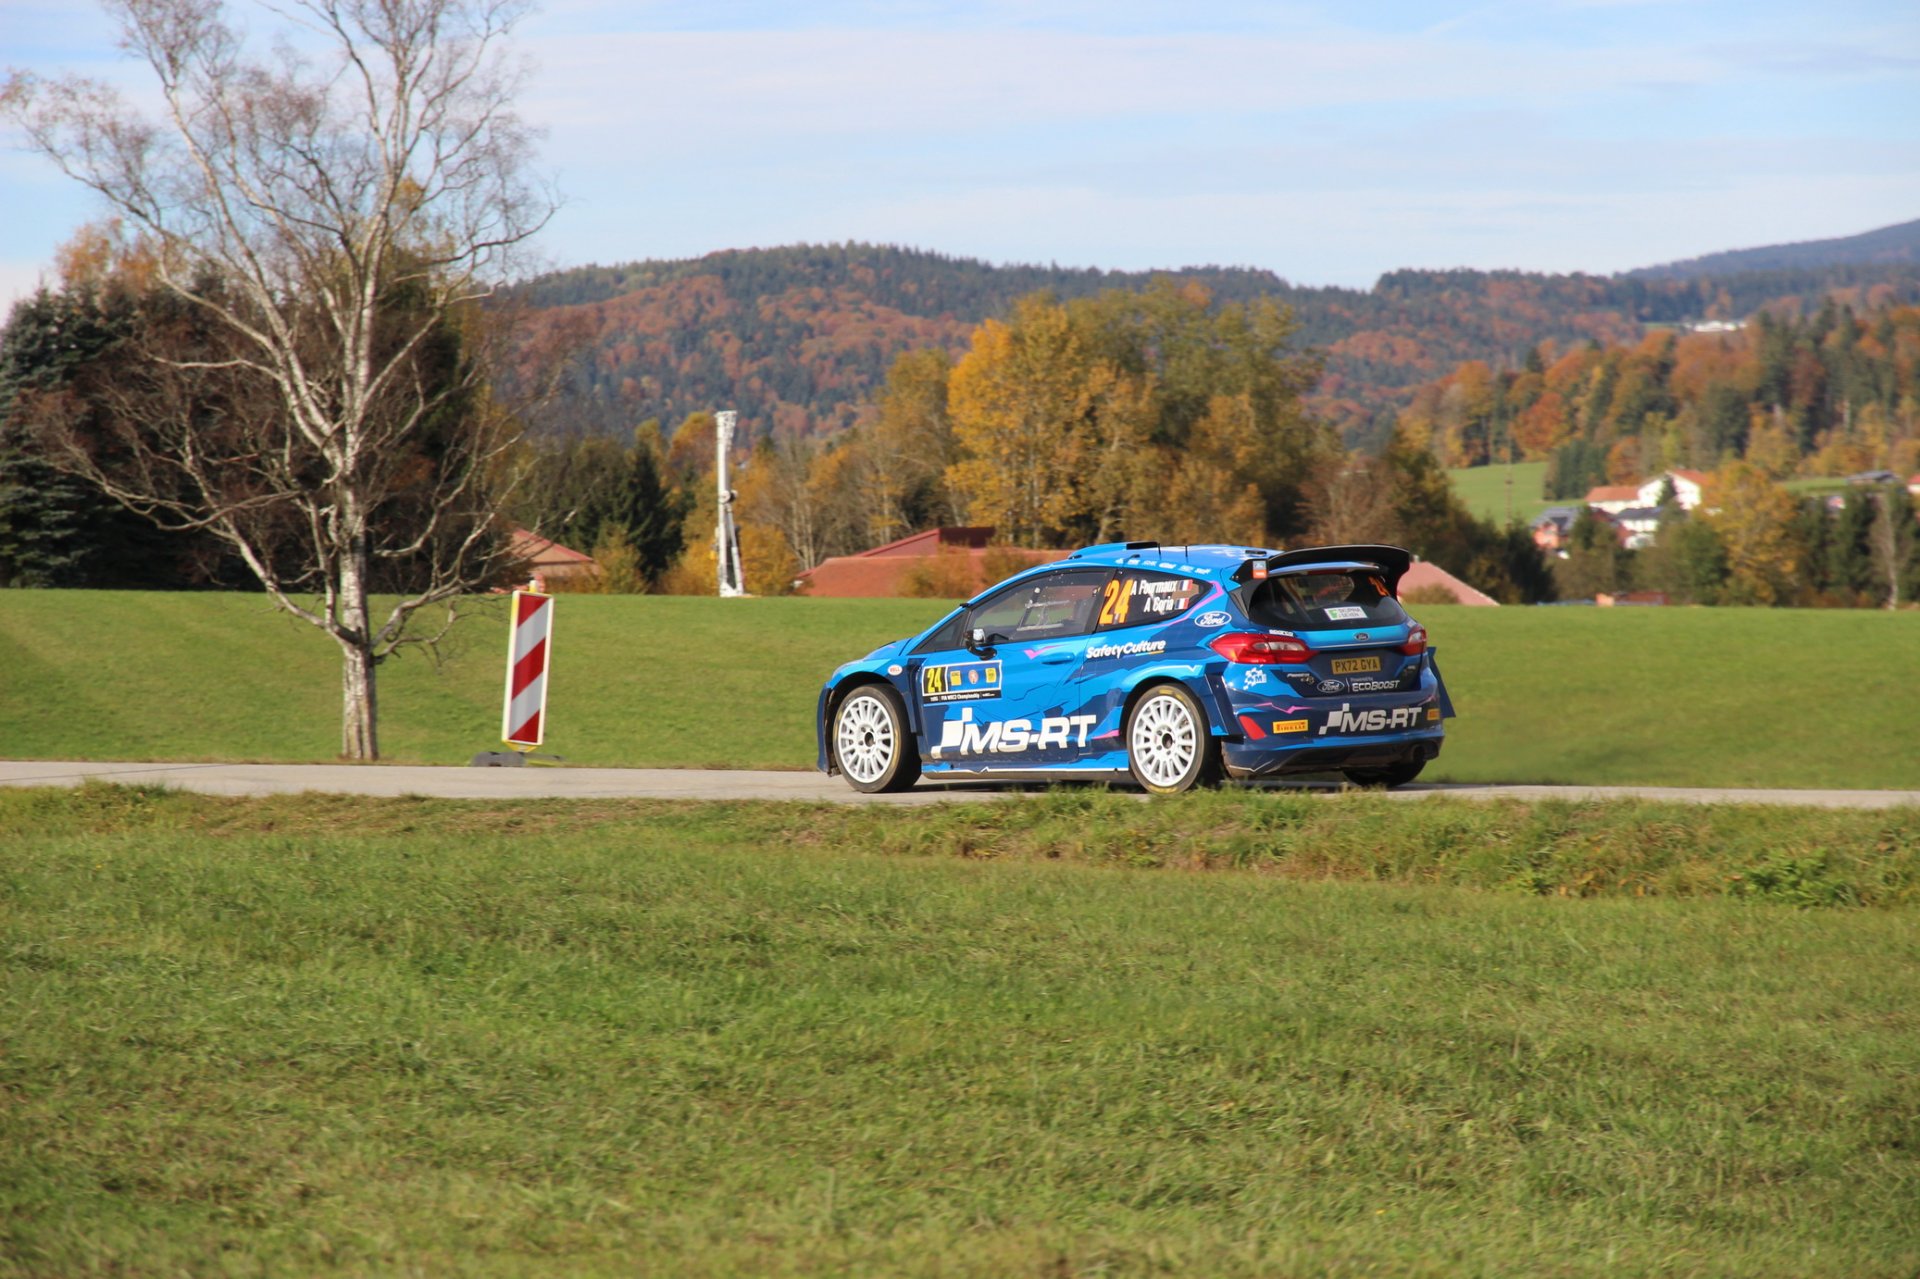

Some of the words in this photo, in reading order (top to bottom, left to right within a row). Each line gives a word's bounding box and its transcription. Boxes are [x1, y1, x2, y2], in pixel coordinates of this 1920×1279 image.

[1130, 582, 1138, 596] A
[1099, 579, 1134, 624] 24
[1143, 598, 1151, 613] A
[1198, 612, 1228, 626] Ford
[1086, 640, 1167, 659] SafetyCulture
[1334, 659, 1359, 672] PX72
[1360, 658, 1378, 670] GYA
[927, 667, 942, 694] 24
[1319, 680, 1343, 692] Ford
[1339, 706, 1422, 733] MS-RT
[959, 714, 1097, 756] MS-RT
